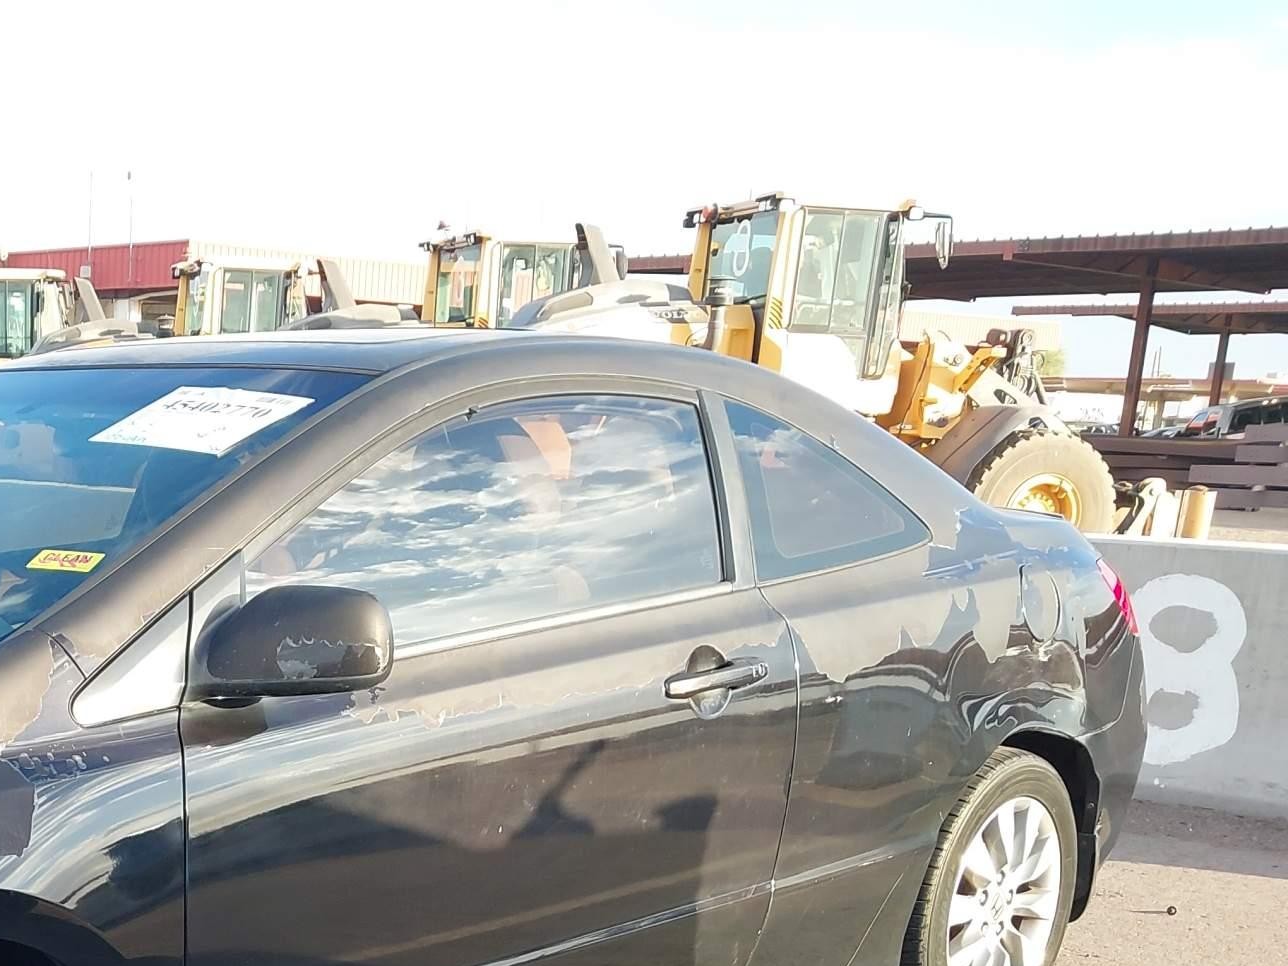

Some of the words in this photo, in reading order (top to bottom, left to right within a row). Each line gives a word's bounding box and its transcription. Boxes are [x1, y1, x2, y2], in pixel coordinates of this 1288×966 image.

[163, 399, 273, 419] 45402770
[42, 552, 94, 564] CLEAN
[1133, 573, 1247, 765] 8
